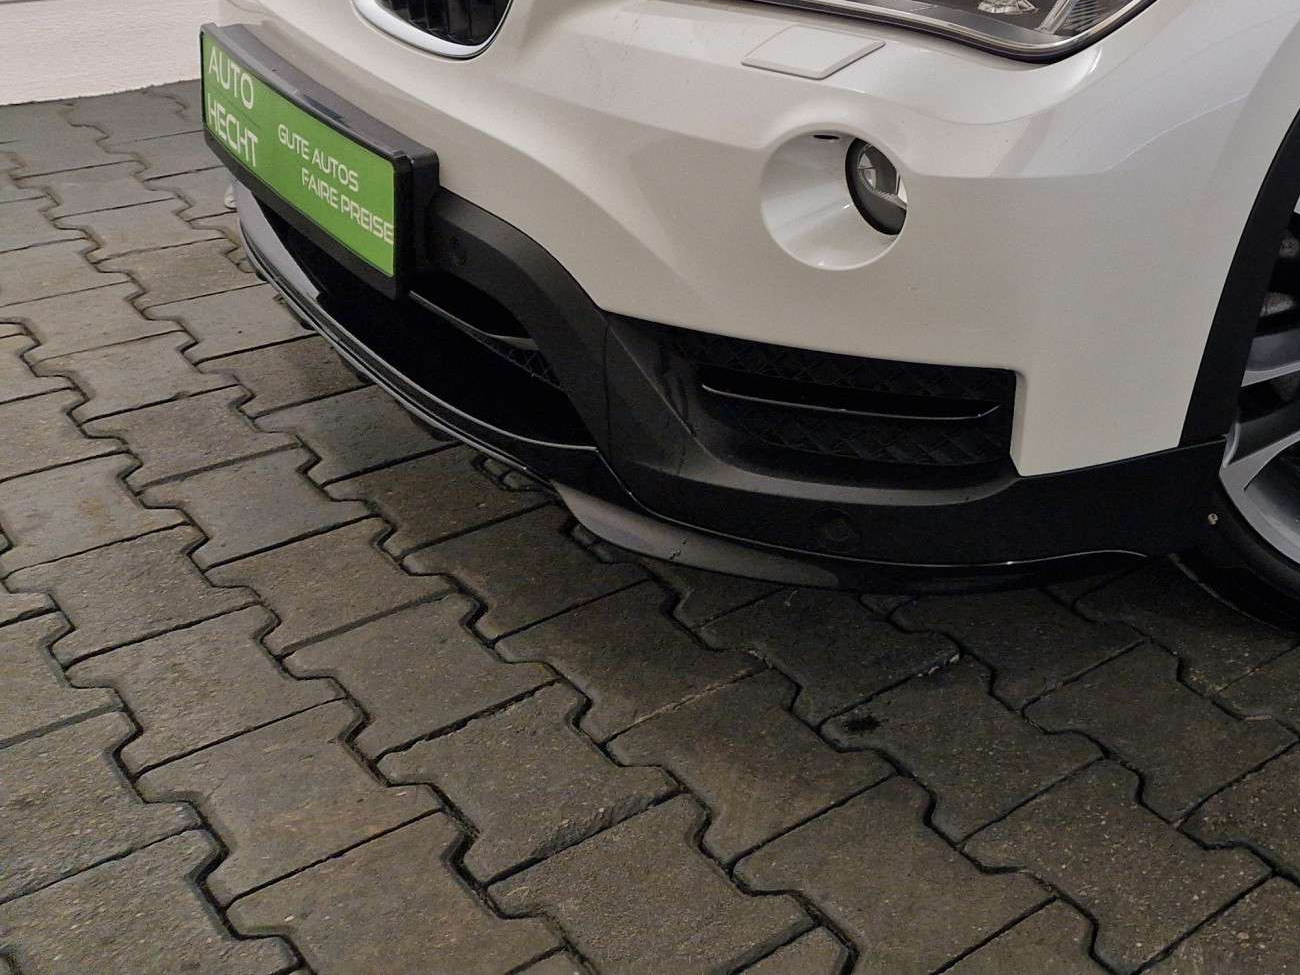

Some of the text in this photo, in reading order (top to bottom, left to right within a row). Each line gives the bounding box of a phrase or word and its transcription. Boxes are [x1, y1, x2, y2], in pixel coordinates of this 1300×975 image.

[208, 46, 254, 109] AUTO
[207, 93, 258, 167] HECHT
[278, 124, 359, 193] GUTE AUTOS
[302, 168, 394, 245] FAIRE PREISE
